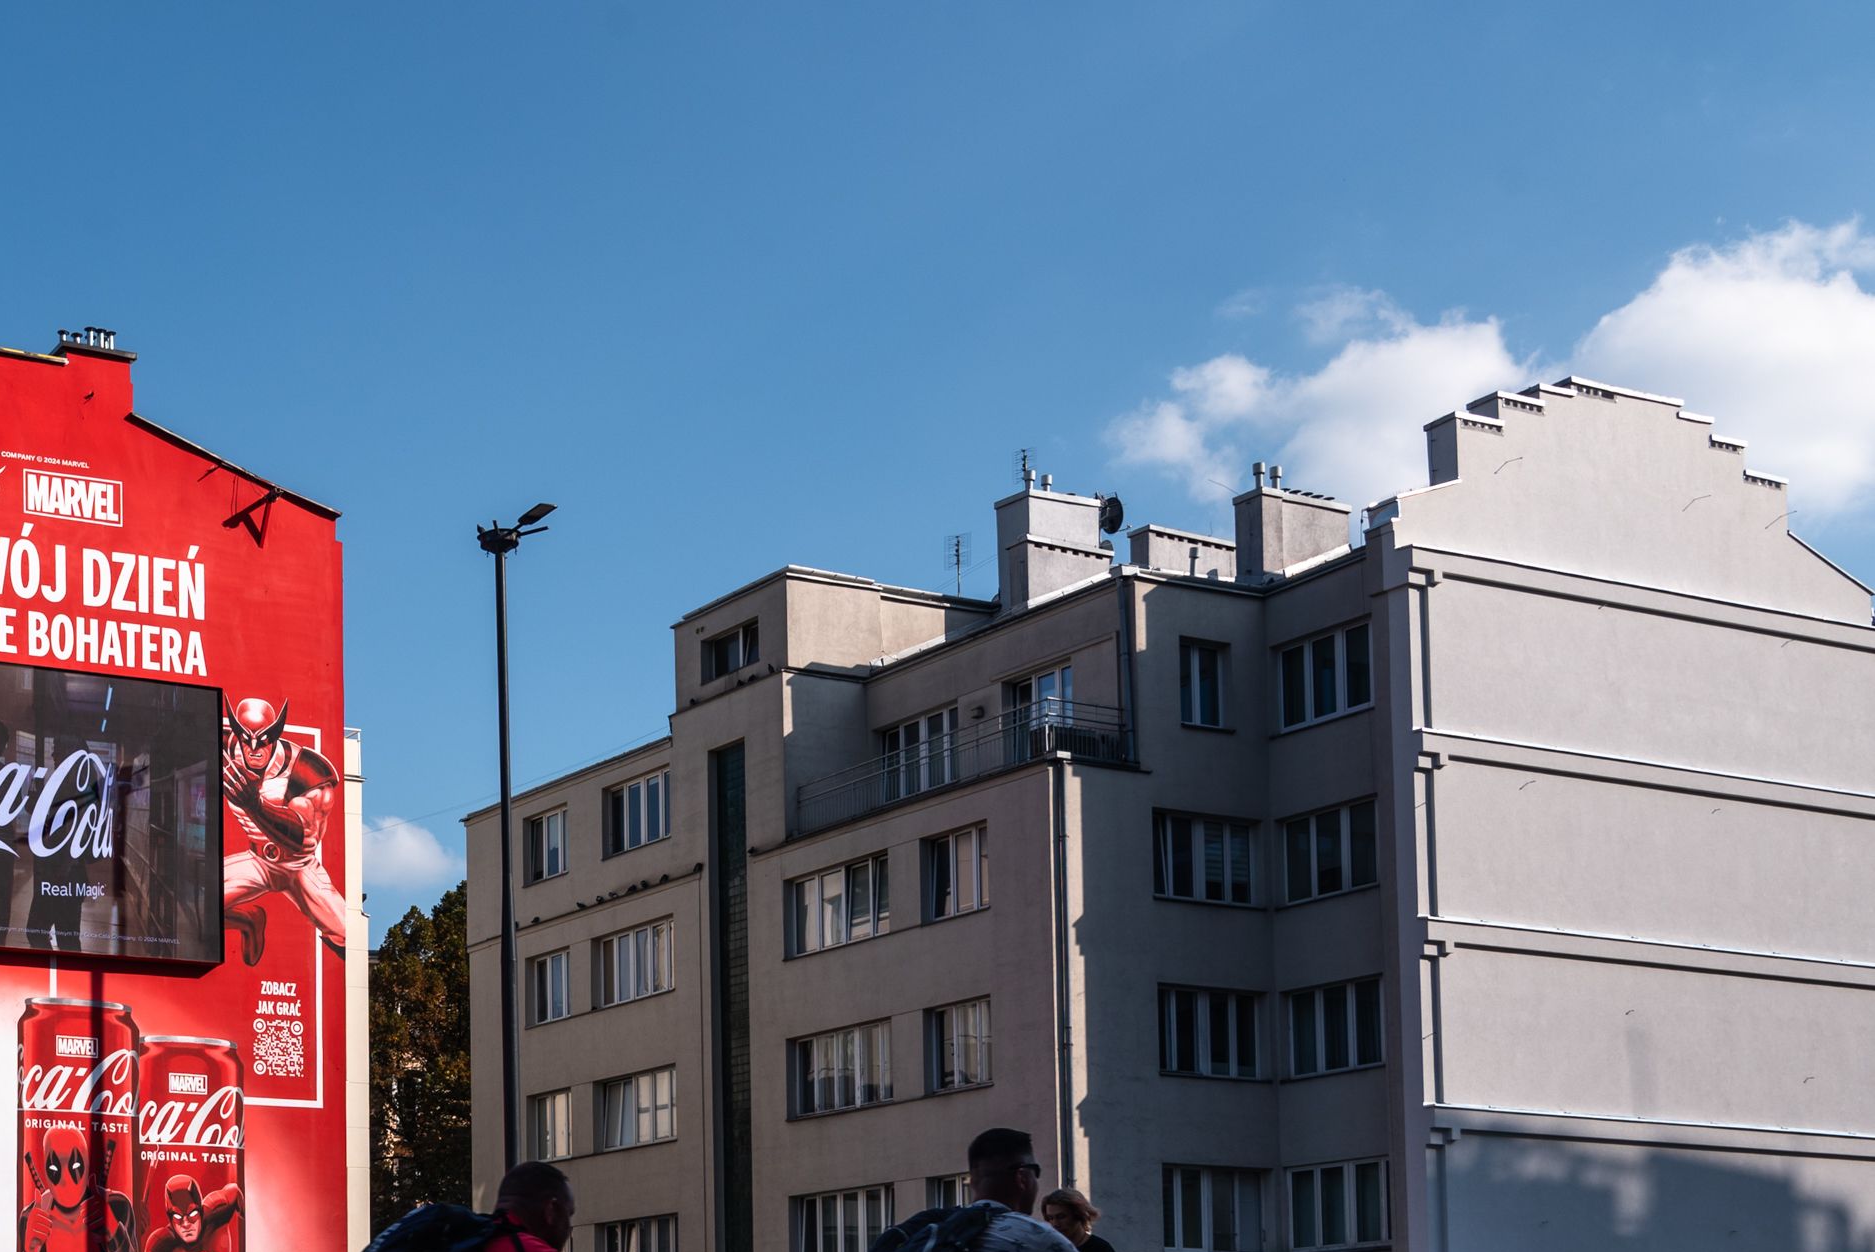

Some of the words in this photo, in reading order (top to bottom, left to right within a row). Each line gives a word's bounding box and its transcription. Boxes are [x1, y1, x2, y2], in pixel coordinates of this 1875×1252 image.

[1, 451, 36, 462] COMPANY
[44, 456, 61, 465] 2024
[62, 459, 90, 469] MARVEL
[27, 474, 119, 523] MARVEL
[83, 546, 205, 620] DZIEŃ
[28, 612, 208, 676] BOHATERA
[41, 882, 72, 897] Real
[76, 882, 105, 899] Magic
[261, 981, 297, 996] ZOBACZ
[256, 1001, 274, 1014] JAK
[276, 1000, 301, 1016] GRAĆ
[58, 1038, 96, 1056] MARVEL
[170, 1075, 206, 1093] MARVEL
[25, 1118, 86, 1130] ORIGINAL
[92, 1122, 129, 1133] TASTE
[140, 1151, 197, 1162] ORIGINAL
[202, 1153, 237, 1164] TASTE
